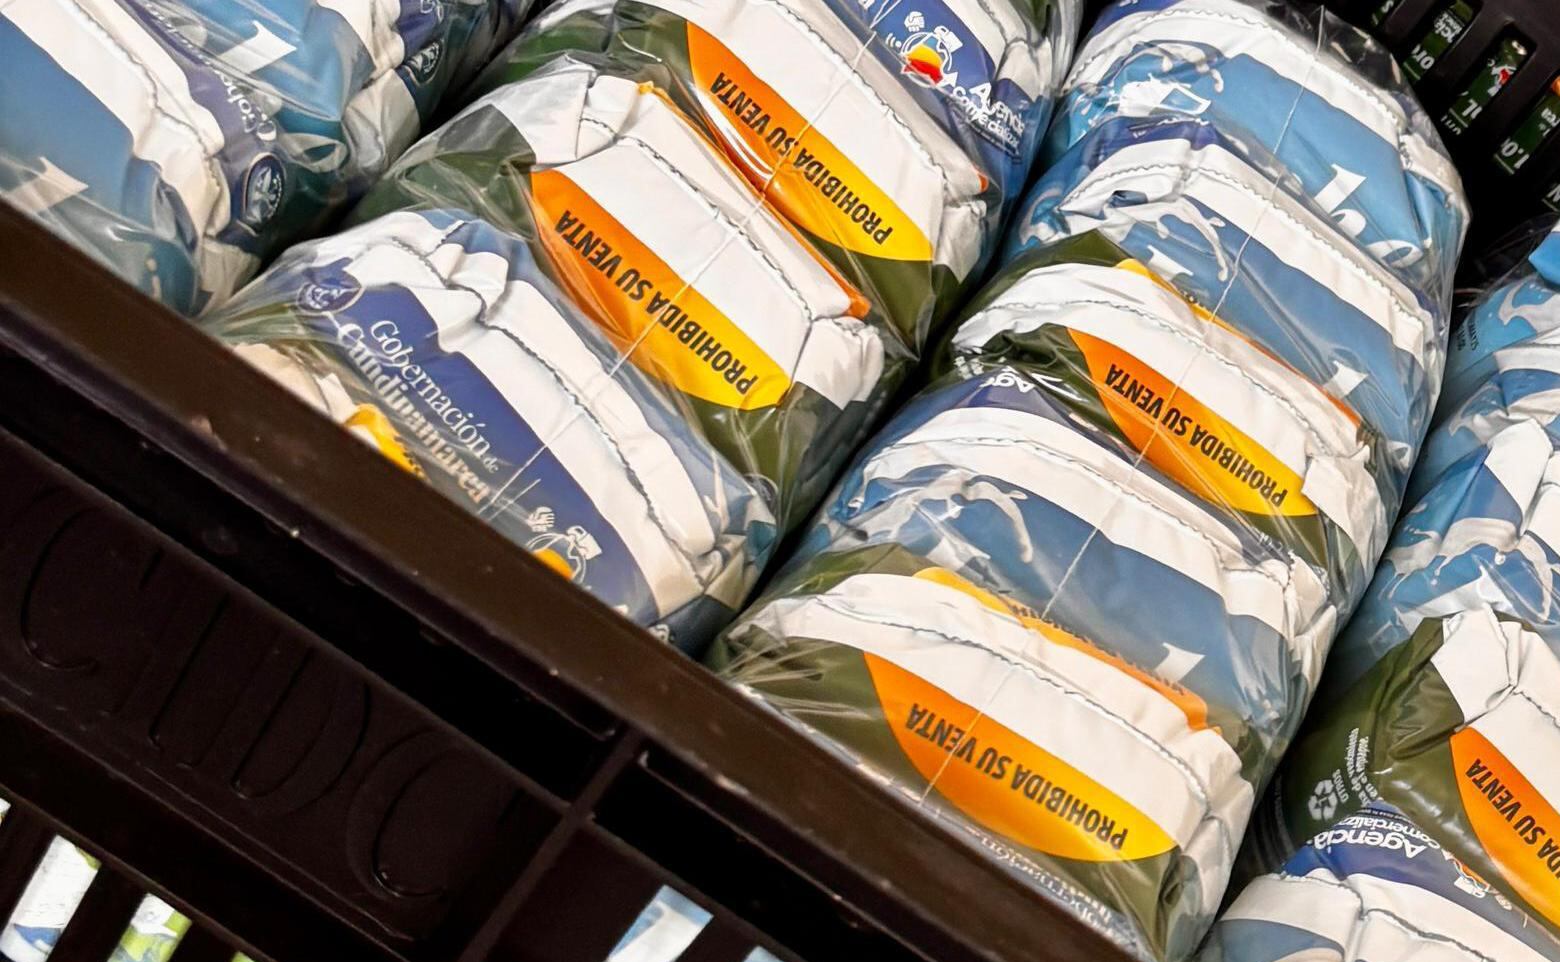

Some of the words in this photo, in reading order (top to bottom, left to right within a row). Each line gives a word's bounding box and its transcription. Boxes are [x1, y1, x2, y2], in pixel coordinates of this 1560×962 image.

[710, 72, 771, 136] VENTA
[765, 127, 799, 156] SU
[793, 148, 893, 245] PROHIBIDA
[555, 210, 622, 278] VENTA
[615, 268, 653, 300] SU
[646, 291, 758, 395] PROHIBIDA
[337, 323, 491, 504] Cundinamarca
[370, 320, 491, 458] Gobernación
[1104, 364, 1165, 419] VENTA
[1161, 407, 1193, 436] SU
[1189, 424, 1288, 507] PROHIBIDA
[905, 703, 977, 764] VENTA
[975, 747, 1012, 780] SU
[1011, 764, 1128, 850] PROHIBIDA
[1466, 758, 1521, 822] VENTA
[1513, 815, 1546, 845] SU
